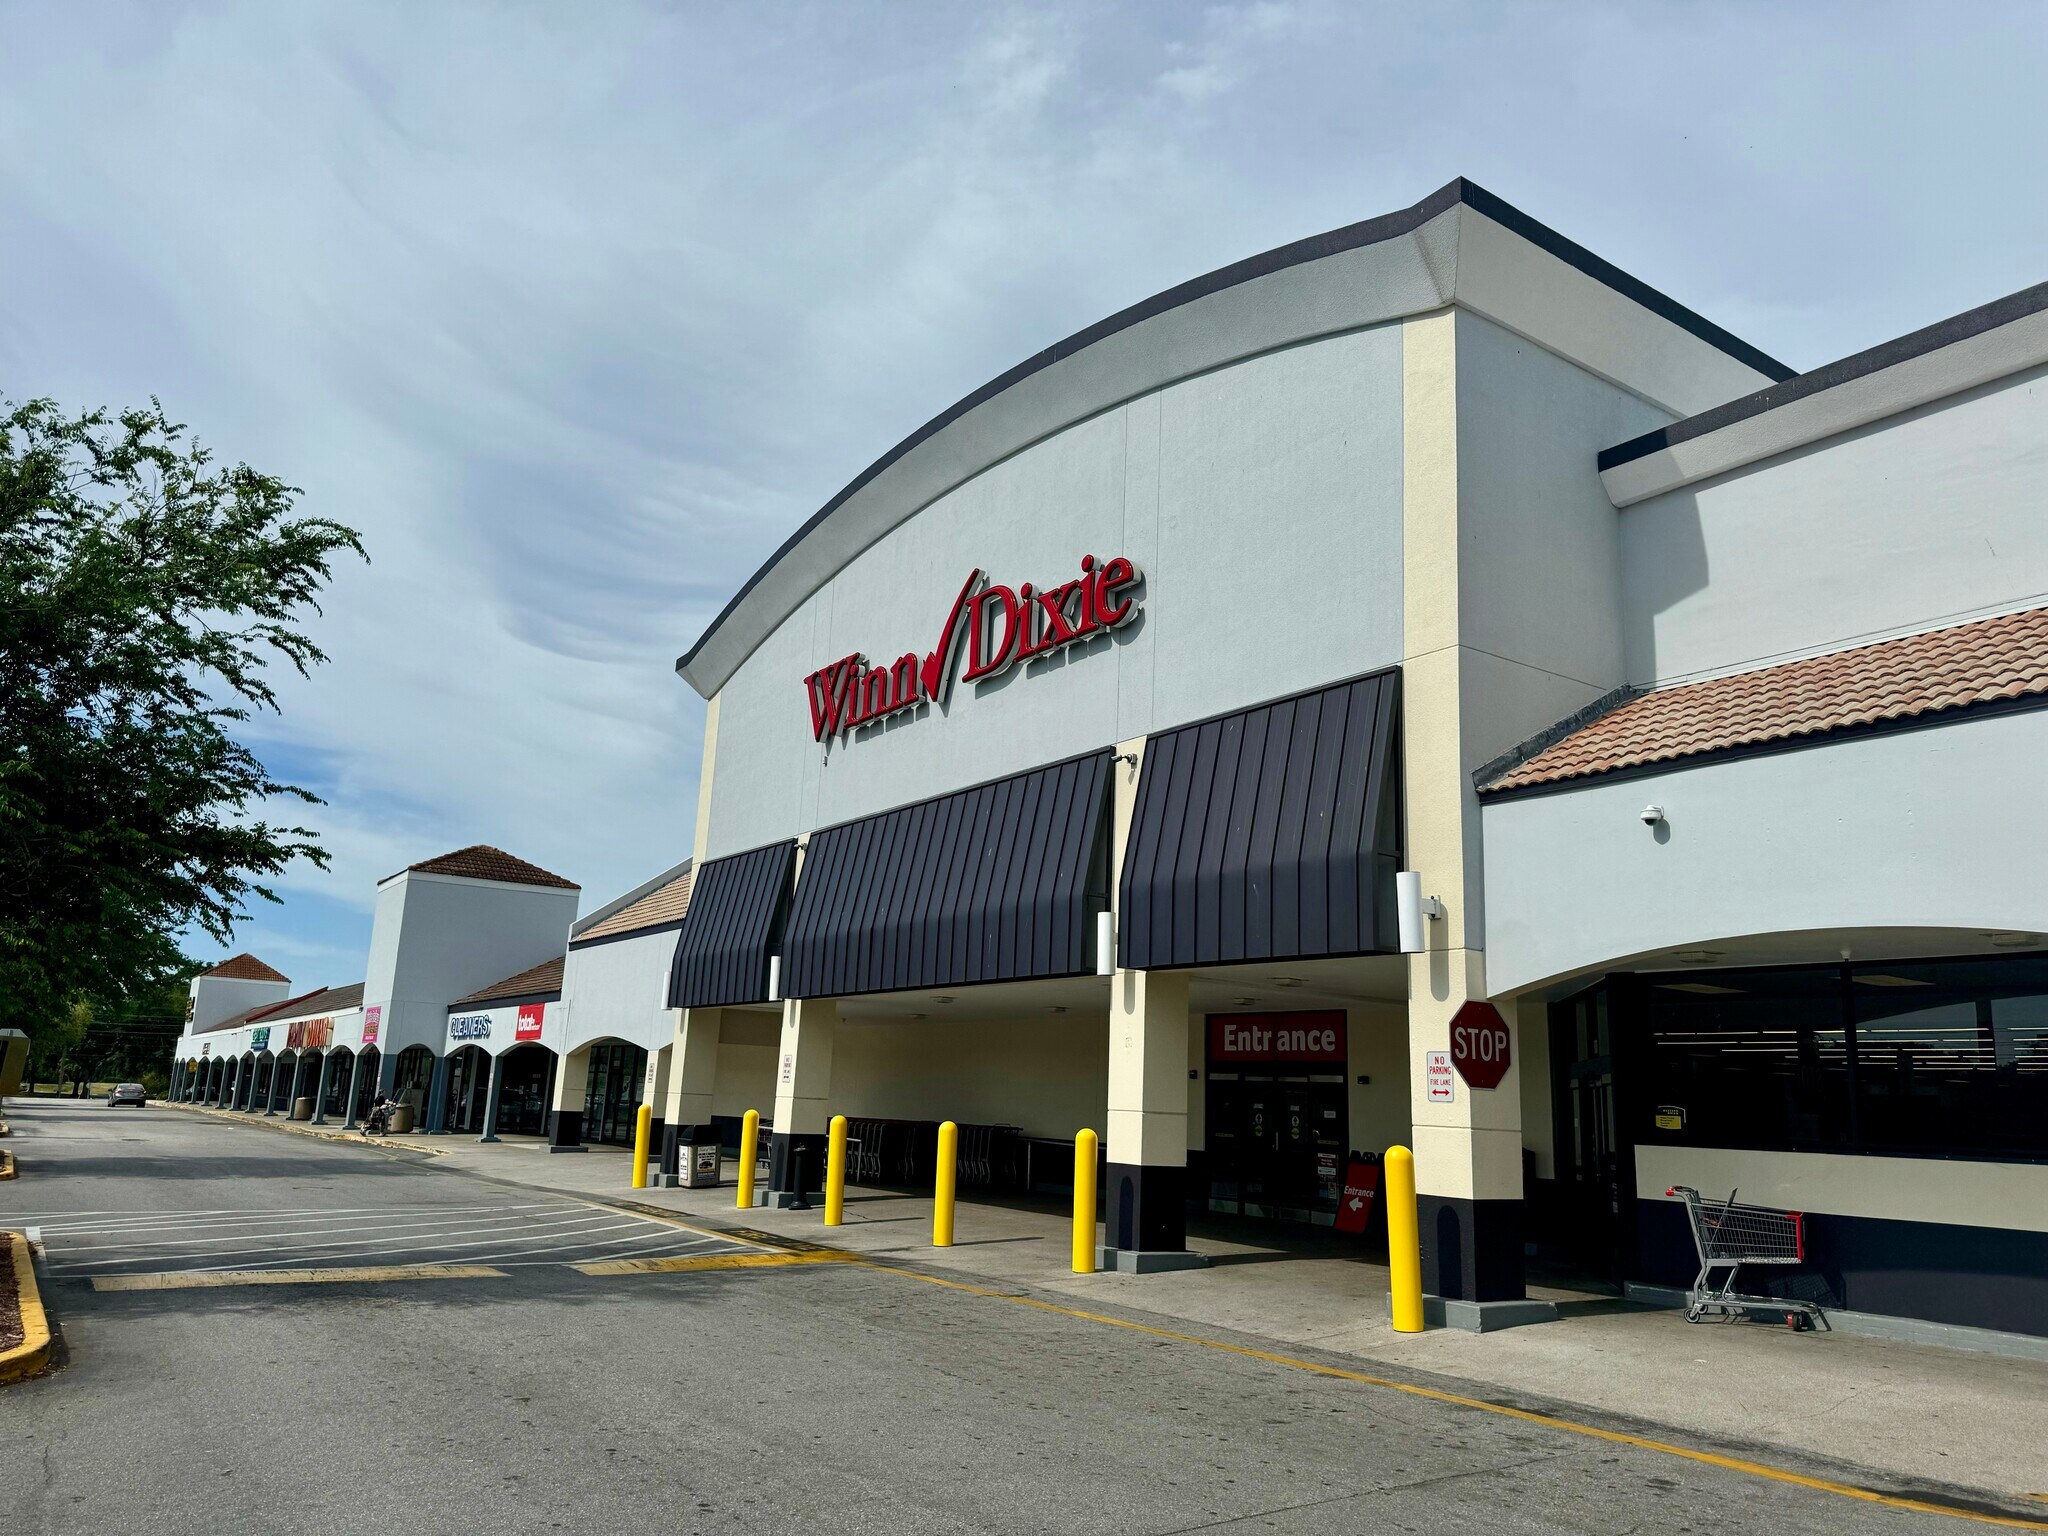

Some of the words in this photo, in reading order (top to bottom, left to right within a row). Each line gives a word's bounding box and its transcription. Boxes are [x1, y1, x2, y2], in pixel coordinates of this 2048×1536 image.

[804, 652, 920, 743] Winn
[962, 554, 1138, 685] Dixie
[450, 1014, 492, 1037] CLEANERS
[1224, 1024, 1336, 1052] Entrance
[1455, 1027, 1506, 1061] STOP
[1429, 1066, 1451, 1075] PARKING
[1434, 1056, 1444, 1065] NO
[1343, 1185, 1375, 1198] Entrance
